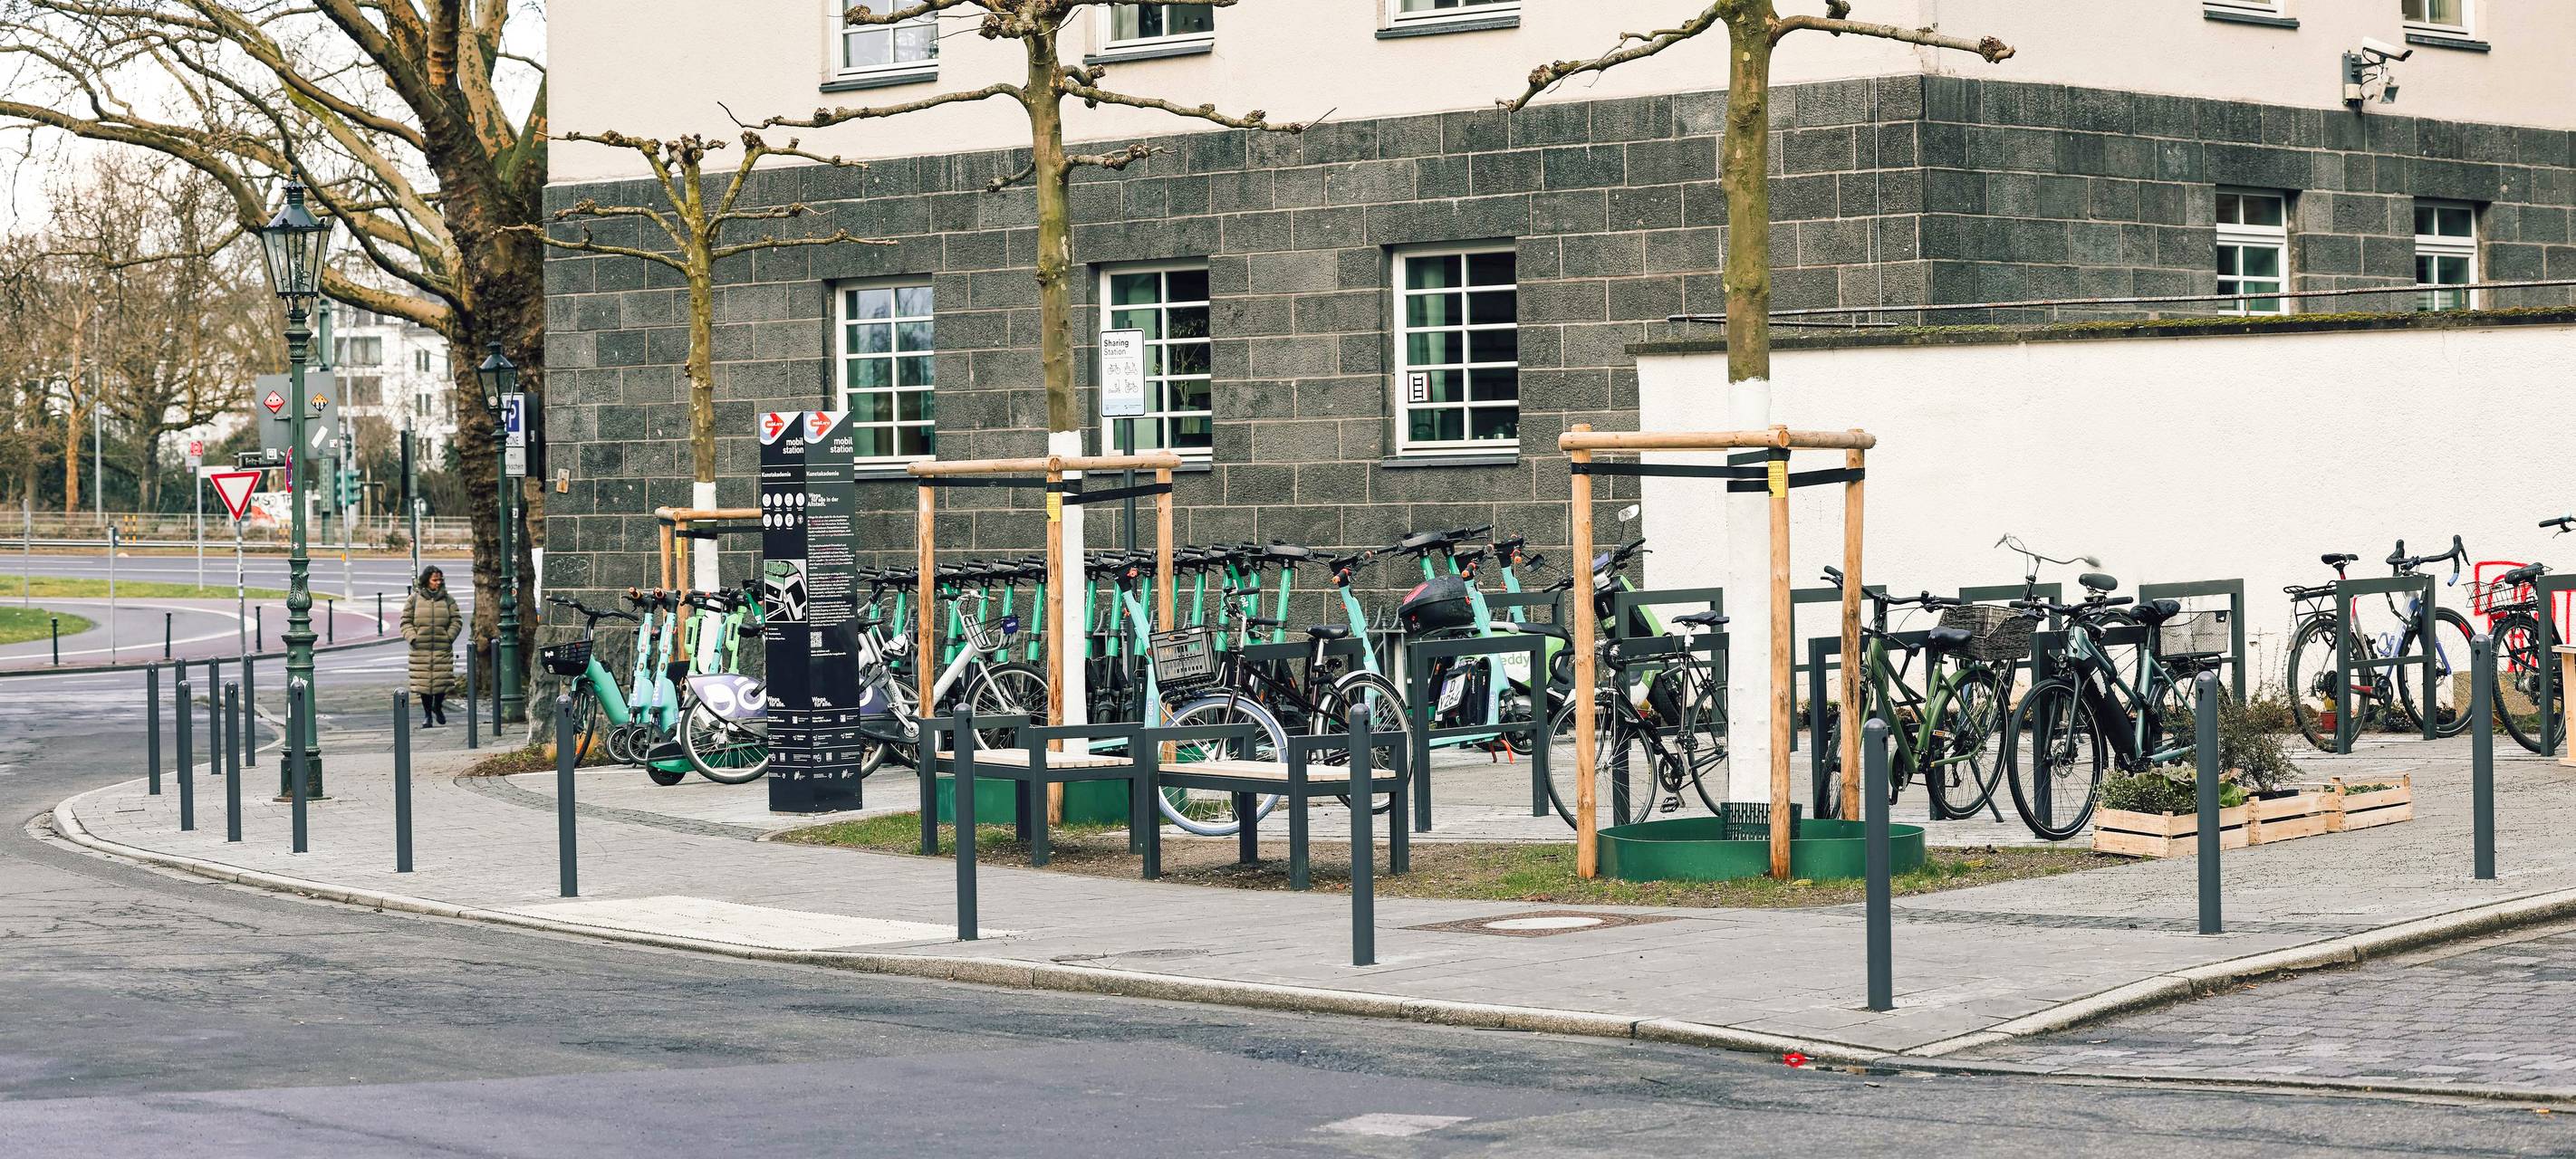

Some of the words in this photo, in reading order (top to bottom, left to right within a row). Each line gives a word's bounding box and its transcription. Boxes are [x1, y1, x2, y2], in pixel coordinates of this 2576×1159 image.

[1103, 339, 1129, 348] Sharing
[1103, 348, 1127, 356] Station
[508, 404, 516, 428] P
[786, 437, 804, 446] mobil
[833, 436, 853, 445] mobil
[783, 446, 804, 455] station
[830, 445, 853, 454] station
[1500, 652, 1530, 667] eddy
